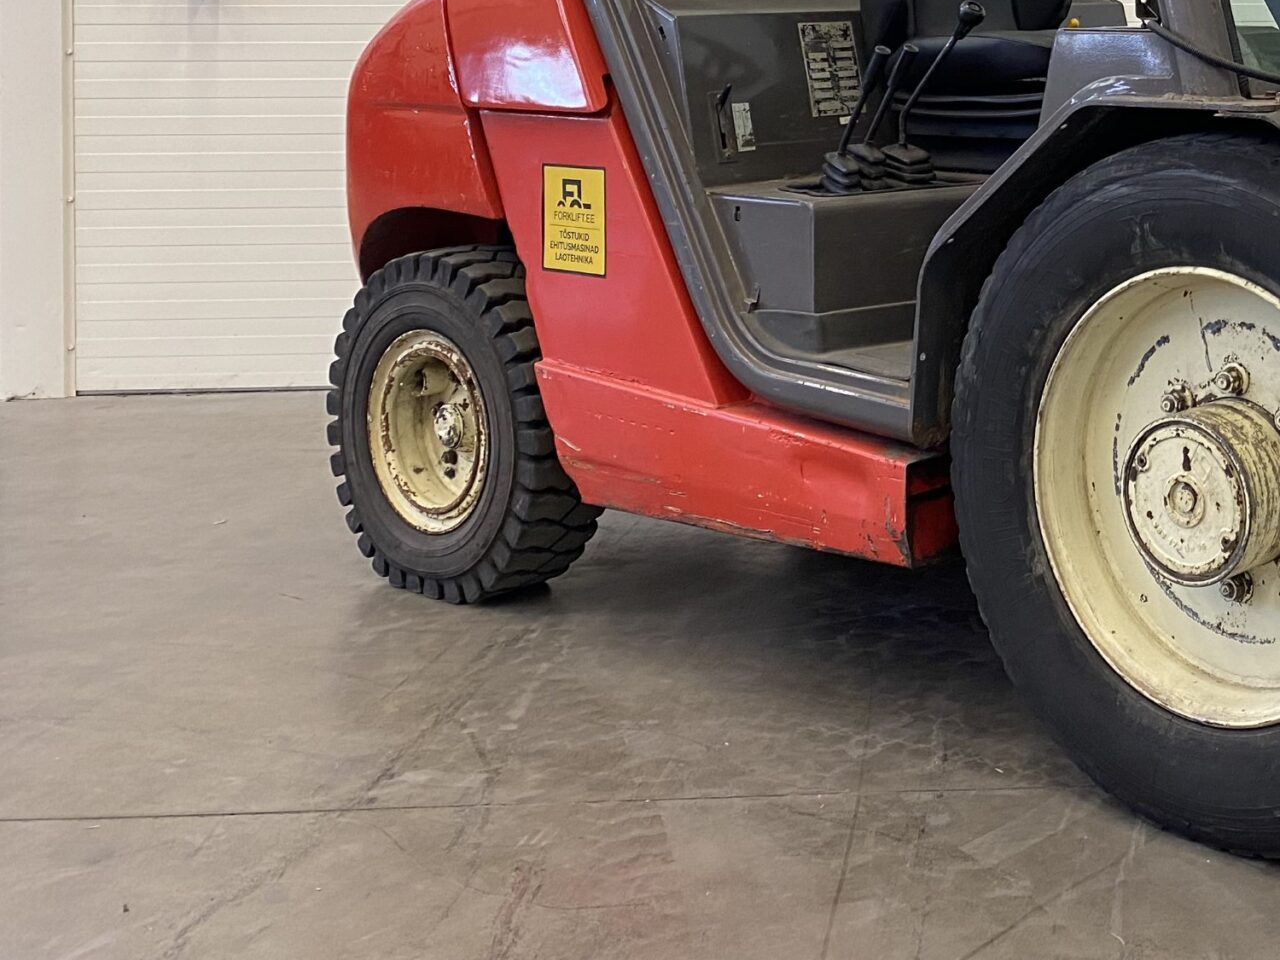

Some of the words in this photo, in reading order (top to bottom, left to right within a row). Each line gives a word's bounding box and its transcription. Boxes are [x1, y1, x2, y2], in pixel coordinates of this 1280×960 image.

[553, 210, 595, 224] FORKLIFT.EE
[550, 240, 600, 254] EHITUSMASINAD
[554, 253, 594, 265] LAOTEHNIKA
